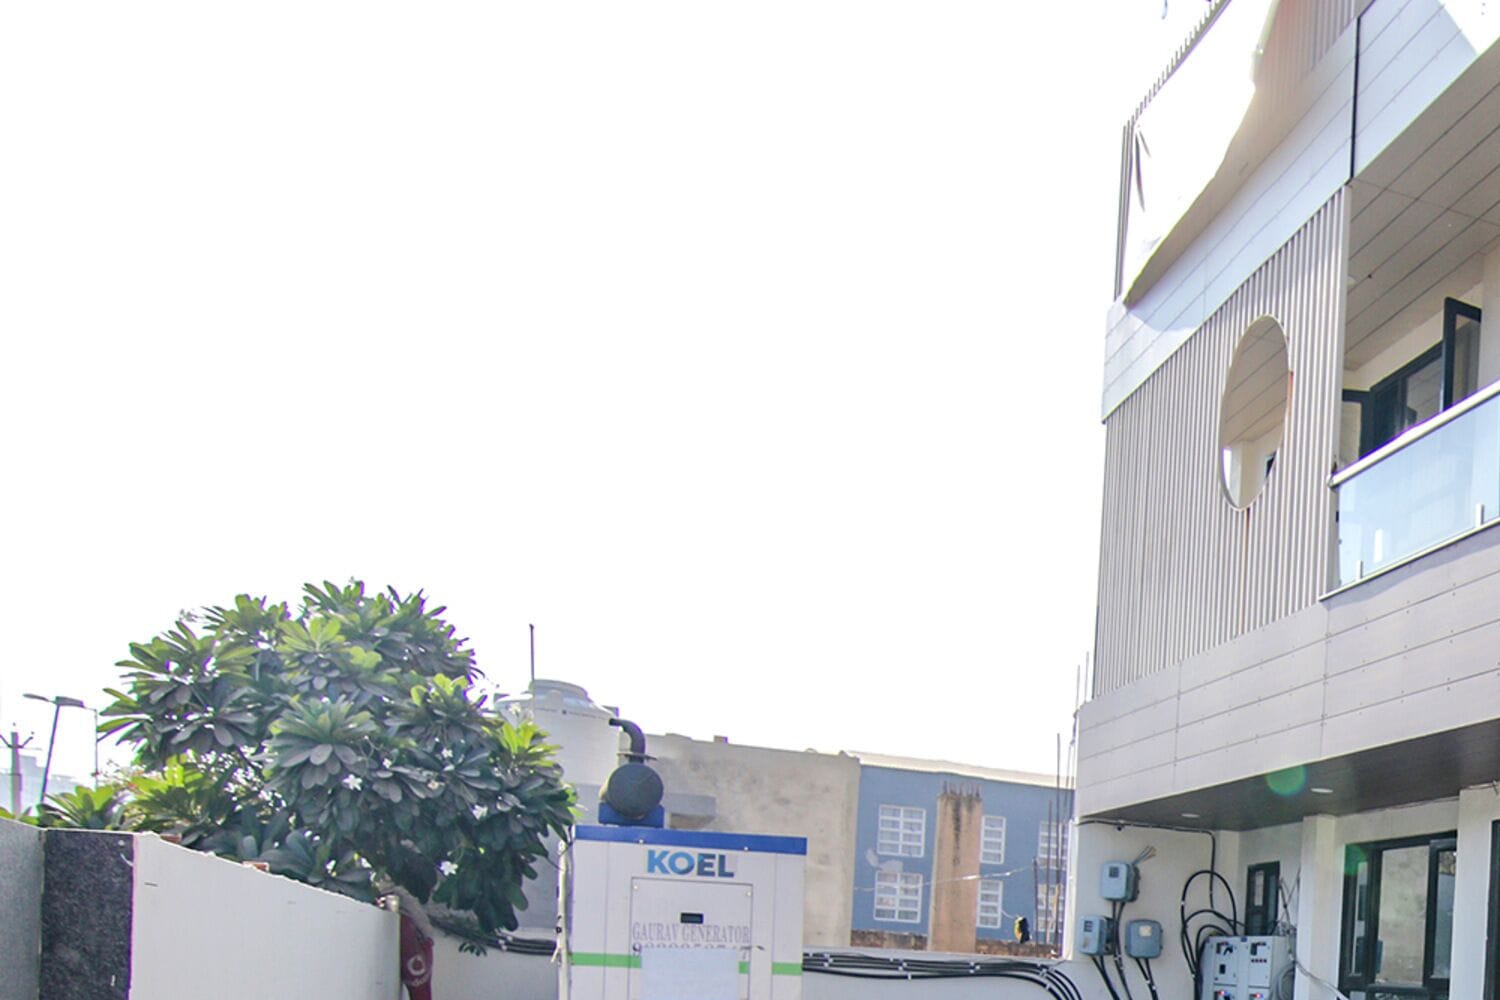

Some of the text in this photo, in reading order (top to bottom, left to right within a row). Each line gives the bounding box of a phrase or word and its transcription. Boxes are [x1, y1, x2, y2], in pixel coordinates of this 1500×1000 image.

[646, 849, 735, 878] KOEL
[632, 921, 750, 944] GAURAV GENERATOR
